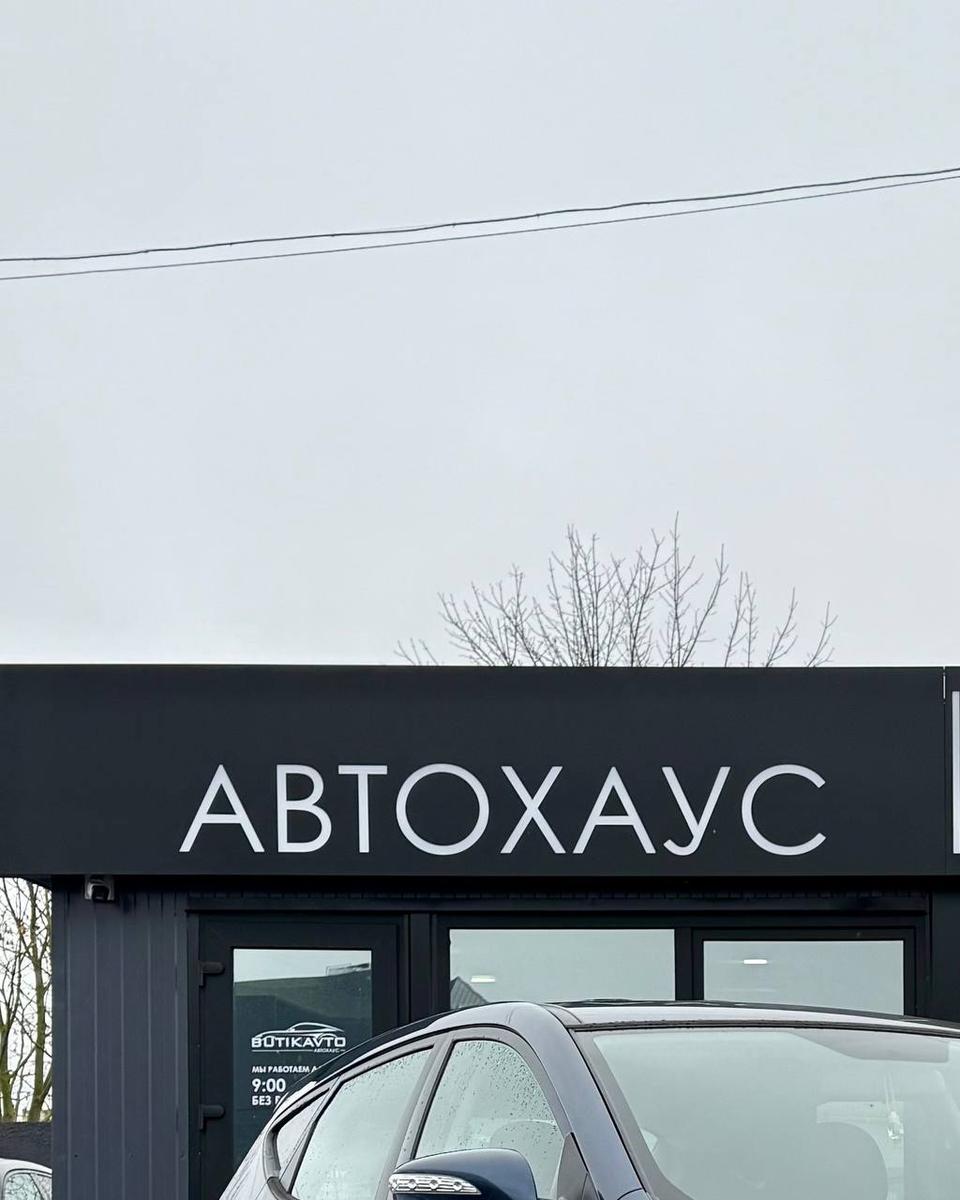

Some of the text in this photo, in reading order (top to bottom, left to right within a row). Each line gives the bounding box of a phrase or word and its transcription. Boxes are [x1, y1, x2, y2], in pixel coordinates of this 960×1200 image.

[180, 763, 827, 857] АВТОХАУС
[251, 1036, 346, 1048] BUTIKAVTO
[252, 1078, 286, 1093] 9:00
[252, 1095, 272, 1105] БЕЗ
